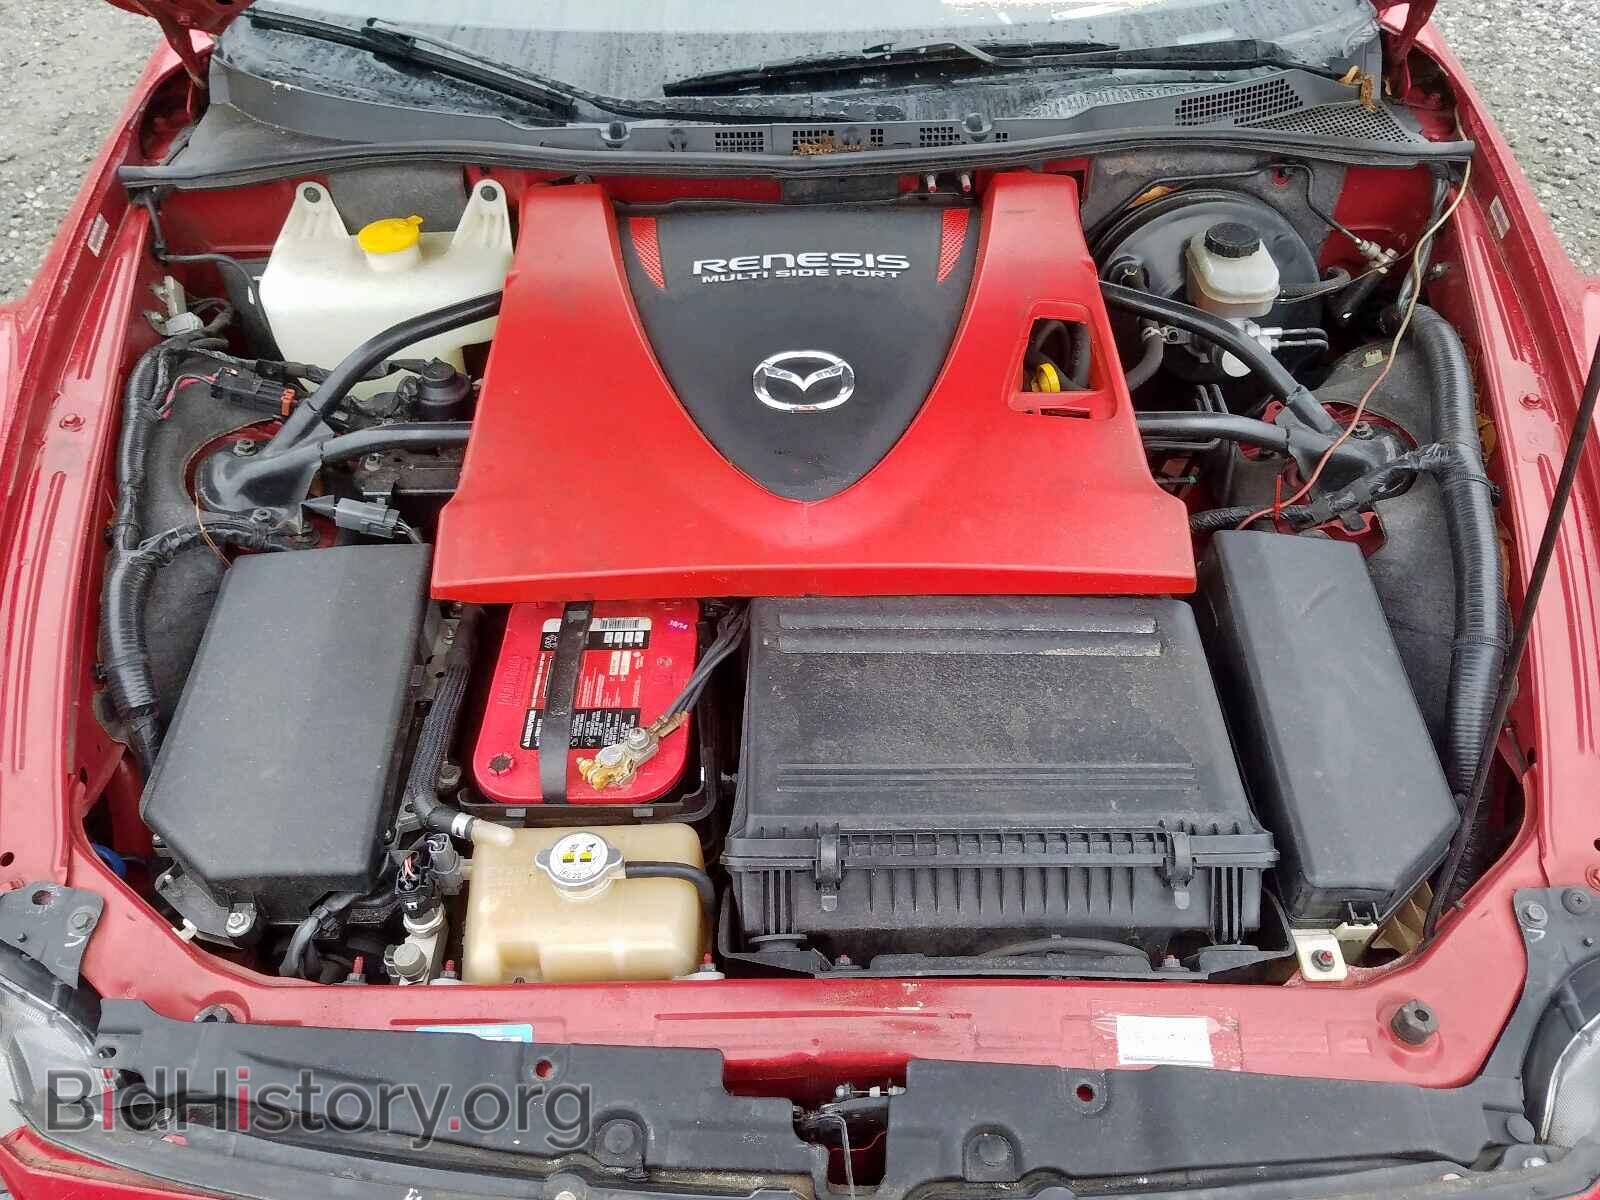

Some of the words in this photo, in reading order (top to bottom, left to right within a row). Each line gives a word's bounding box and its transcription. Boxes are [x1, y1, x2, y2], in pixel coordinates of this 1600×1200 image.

[693, 252, 911, 275] RENESIS
[702, 270, 769, 283] MULTI
[775, 268, 831, 278] SIDE
[836, 268, 902, 279] PORT
